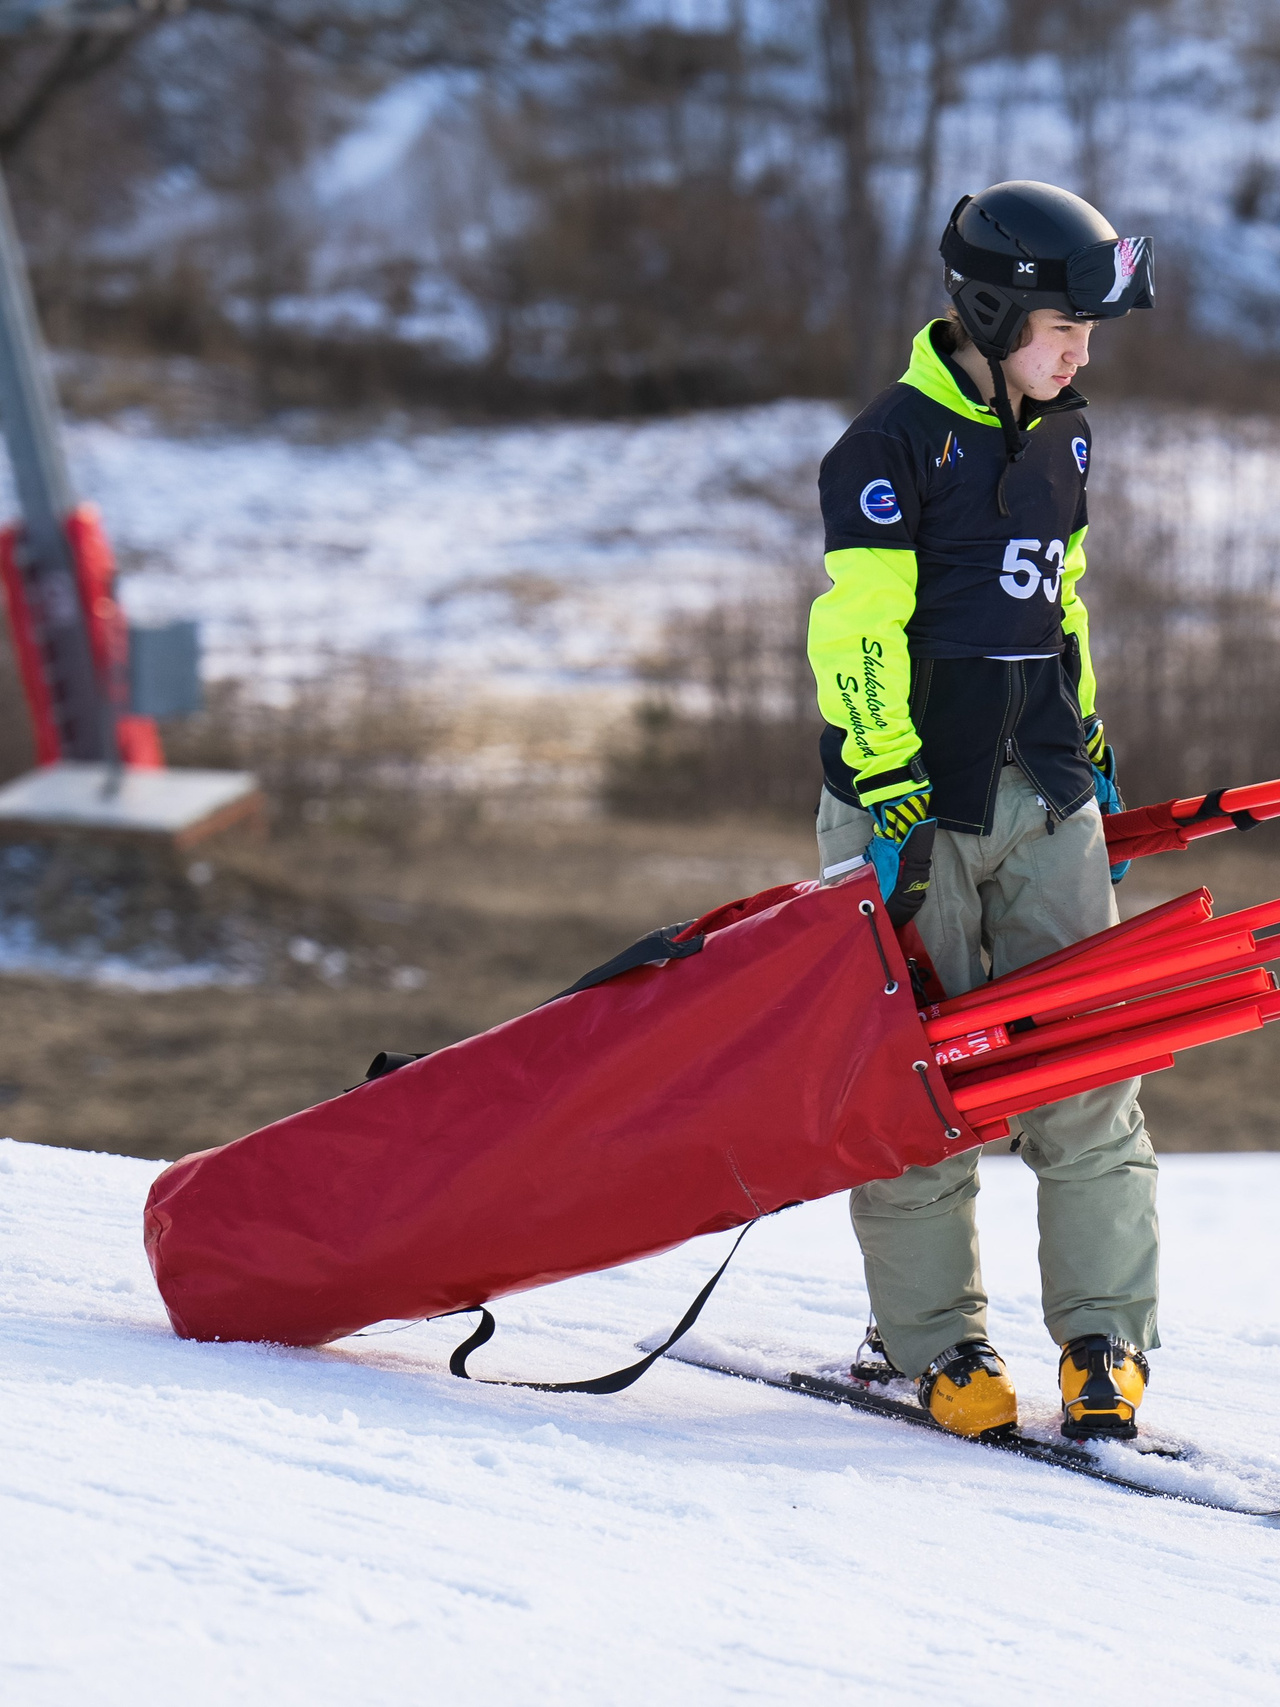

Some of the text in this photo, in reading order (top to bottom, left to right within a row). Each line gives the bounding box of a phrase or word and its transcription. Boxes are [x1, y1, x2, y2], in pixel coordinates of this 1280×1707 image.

[935, 447, 964, 468] FIS
[999, 539, 1065, 603] 53
[862, 637, 888, 729] Shukolovo
